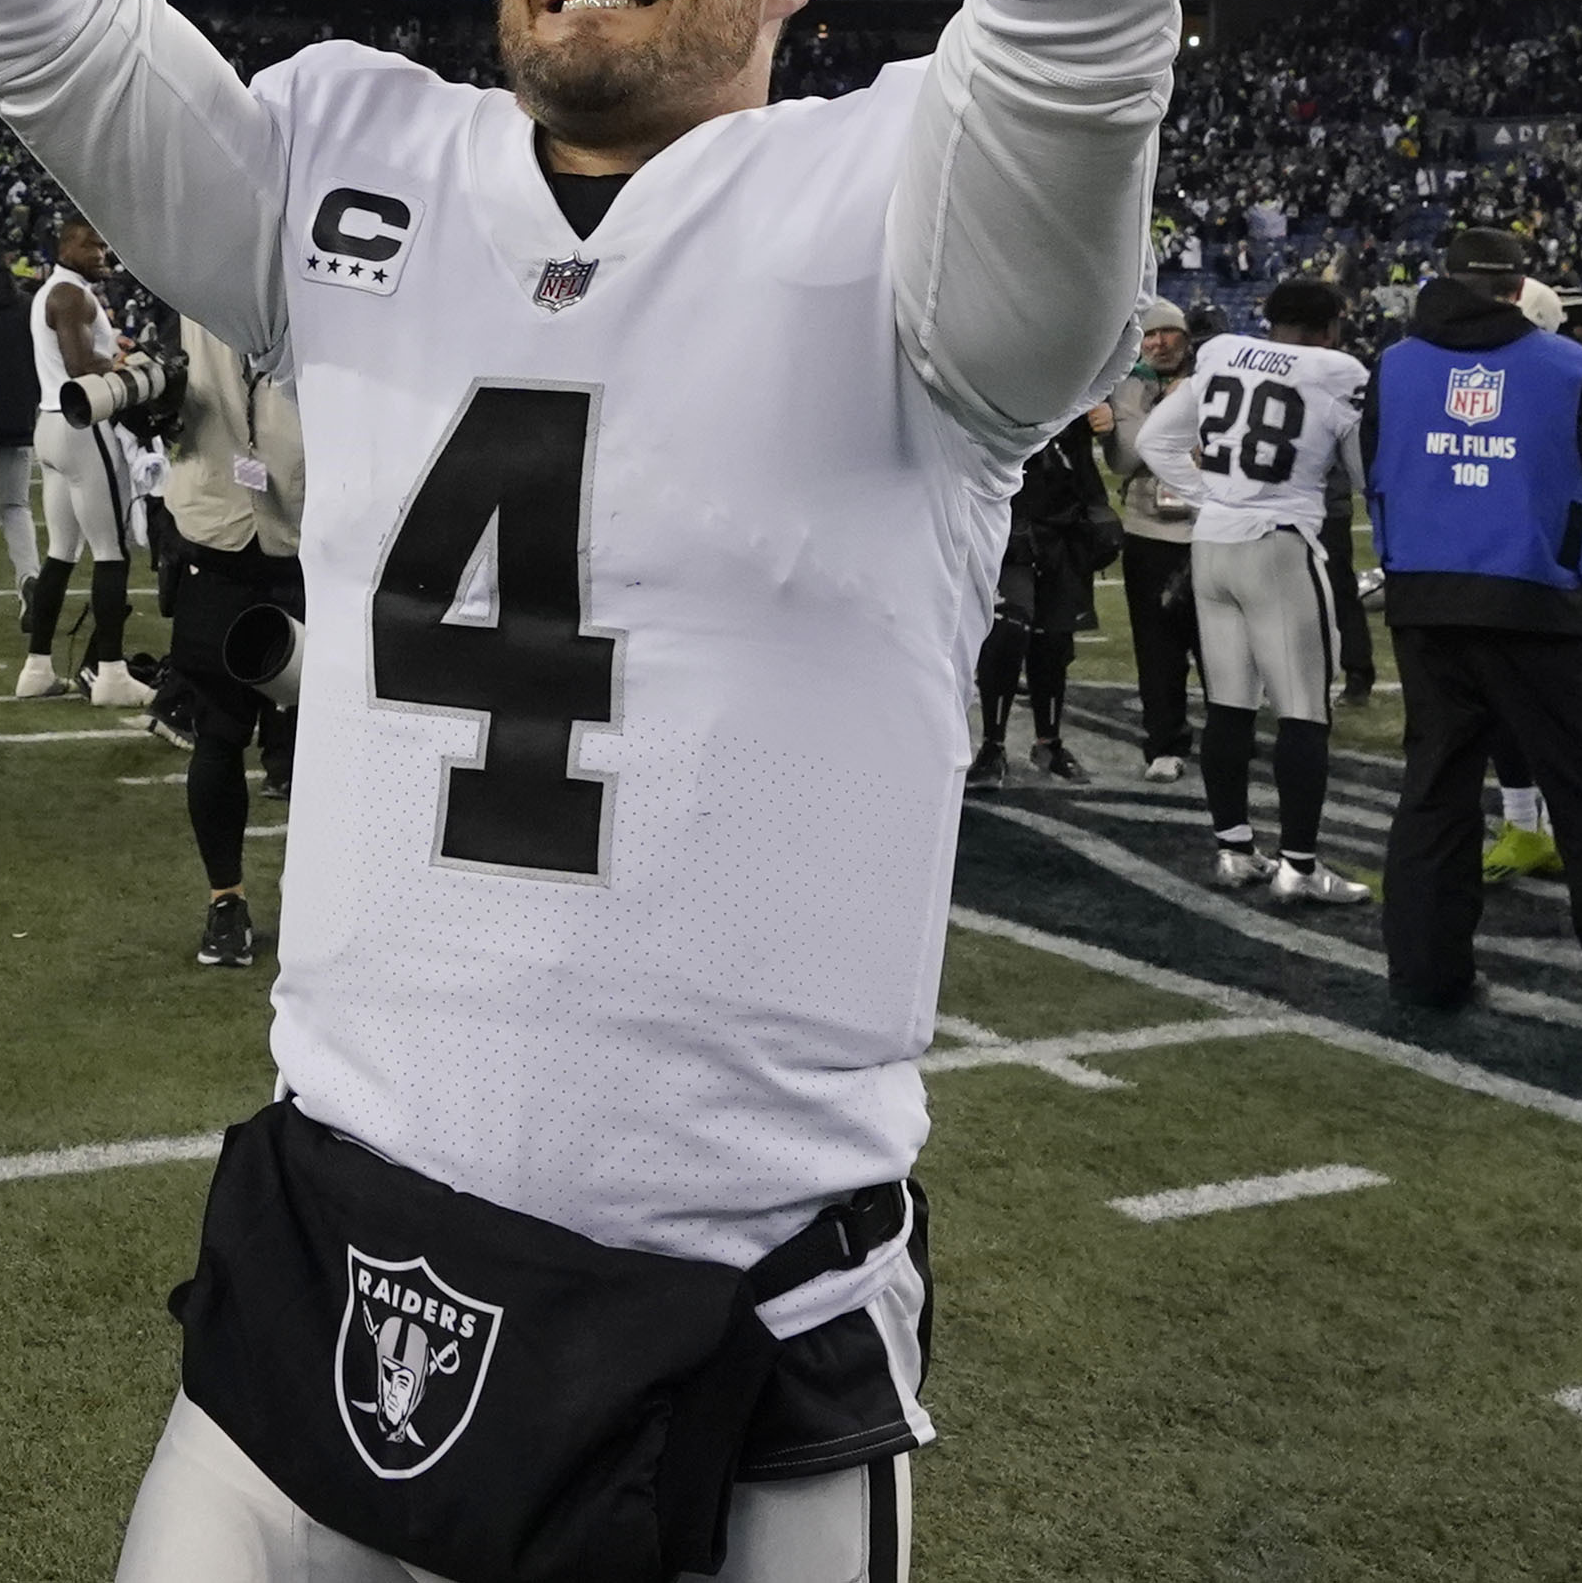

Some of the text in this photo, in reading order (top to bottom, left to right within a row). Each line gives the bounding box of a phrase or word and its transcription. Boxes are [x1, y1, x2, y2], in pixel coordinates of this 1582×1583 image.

[312, 187, 411, 261] C
[541, 278, 579, 299] NFL
[1228, 347, 1299, 376] JACOBS
[1454, 390, 1494, 415] NFL
[1200, 374, 1305, 484] 28
[1426, 431, 1517, 460] NFL FILMS
[1451, 462, 1490, 487] 106
[366, 377, 629, 888] 4
[358, 1268, 477, 1338] RAIDERS
